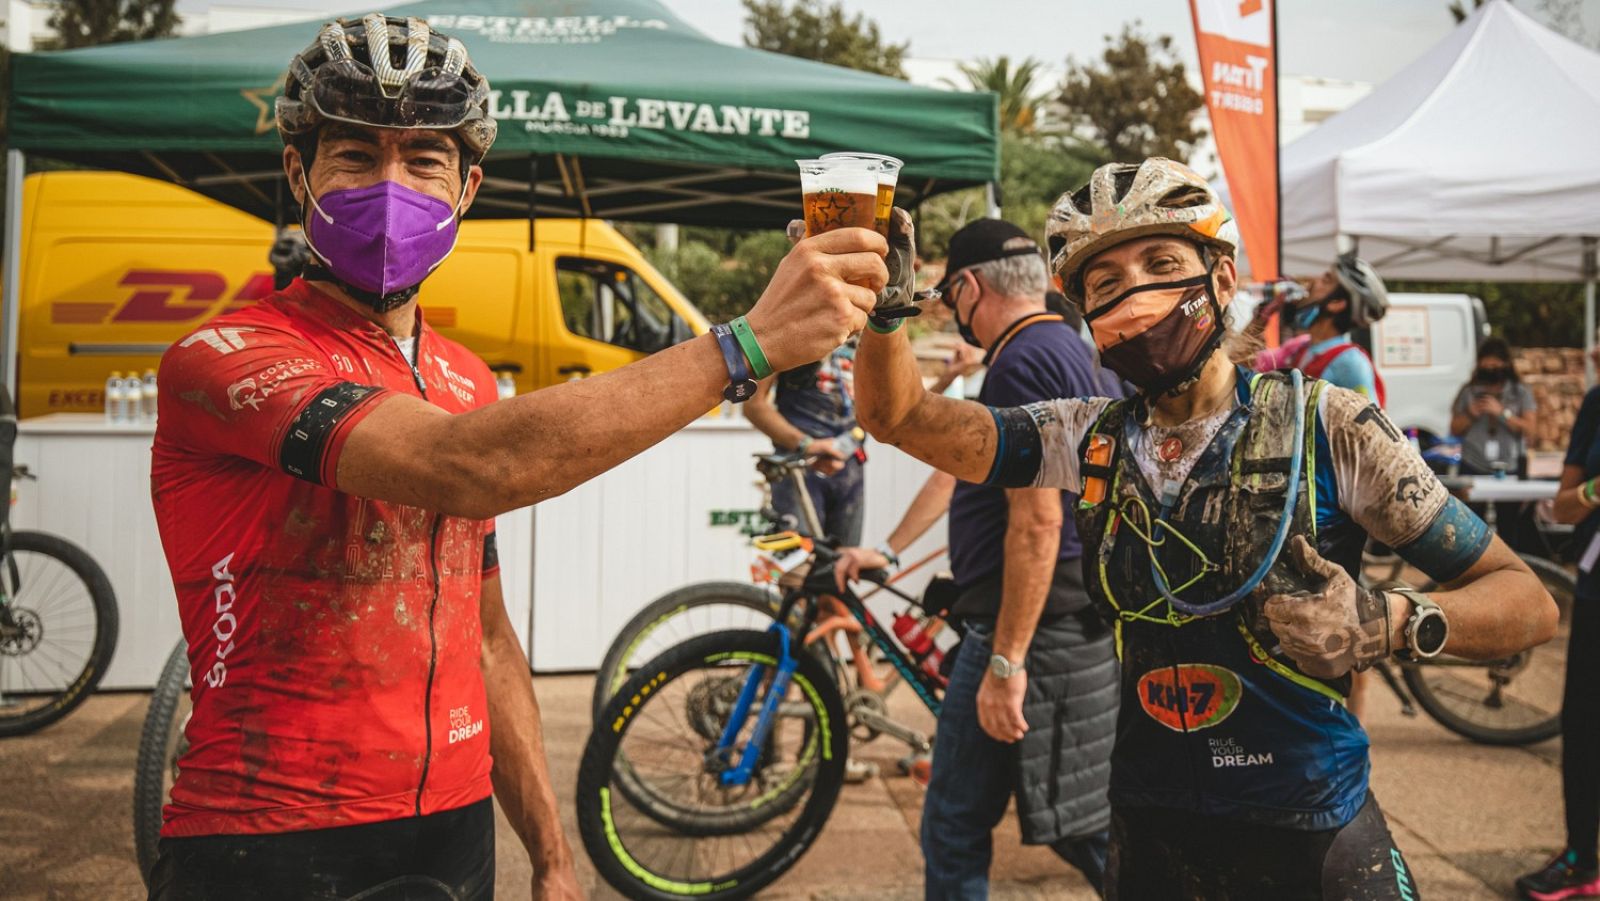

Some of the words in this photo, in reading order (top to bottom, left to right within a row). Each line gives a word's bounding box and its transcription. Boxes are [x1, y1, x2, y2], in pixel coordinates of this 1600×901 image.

[576, 101, 606, 118] DE
[608, 96, 811, 139] LEVANTE
[449, 705, 469, 719] RIDE
[449, 719, 483, 744] DREAM
[1208, 737, 1236, 747] RIDE
[1211, 746, 1244, 756] YOUR
[1212, 752, 1273, 768] DREAM
